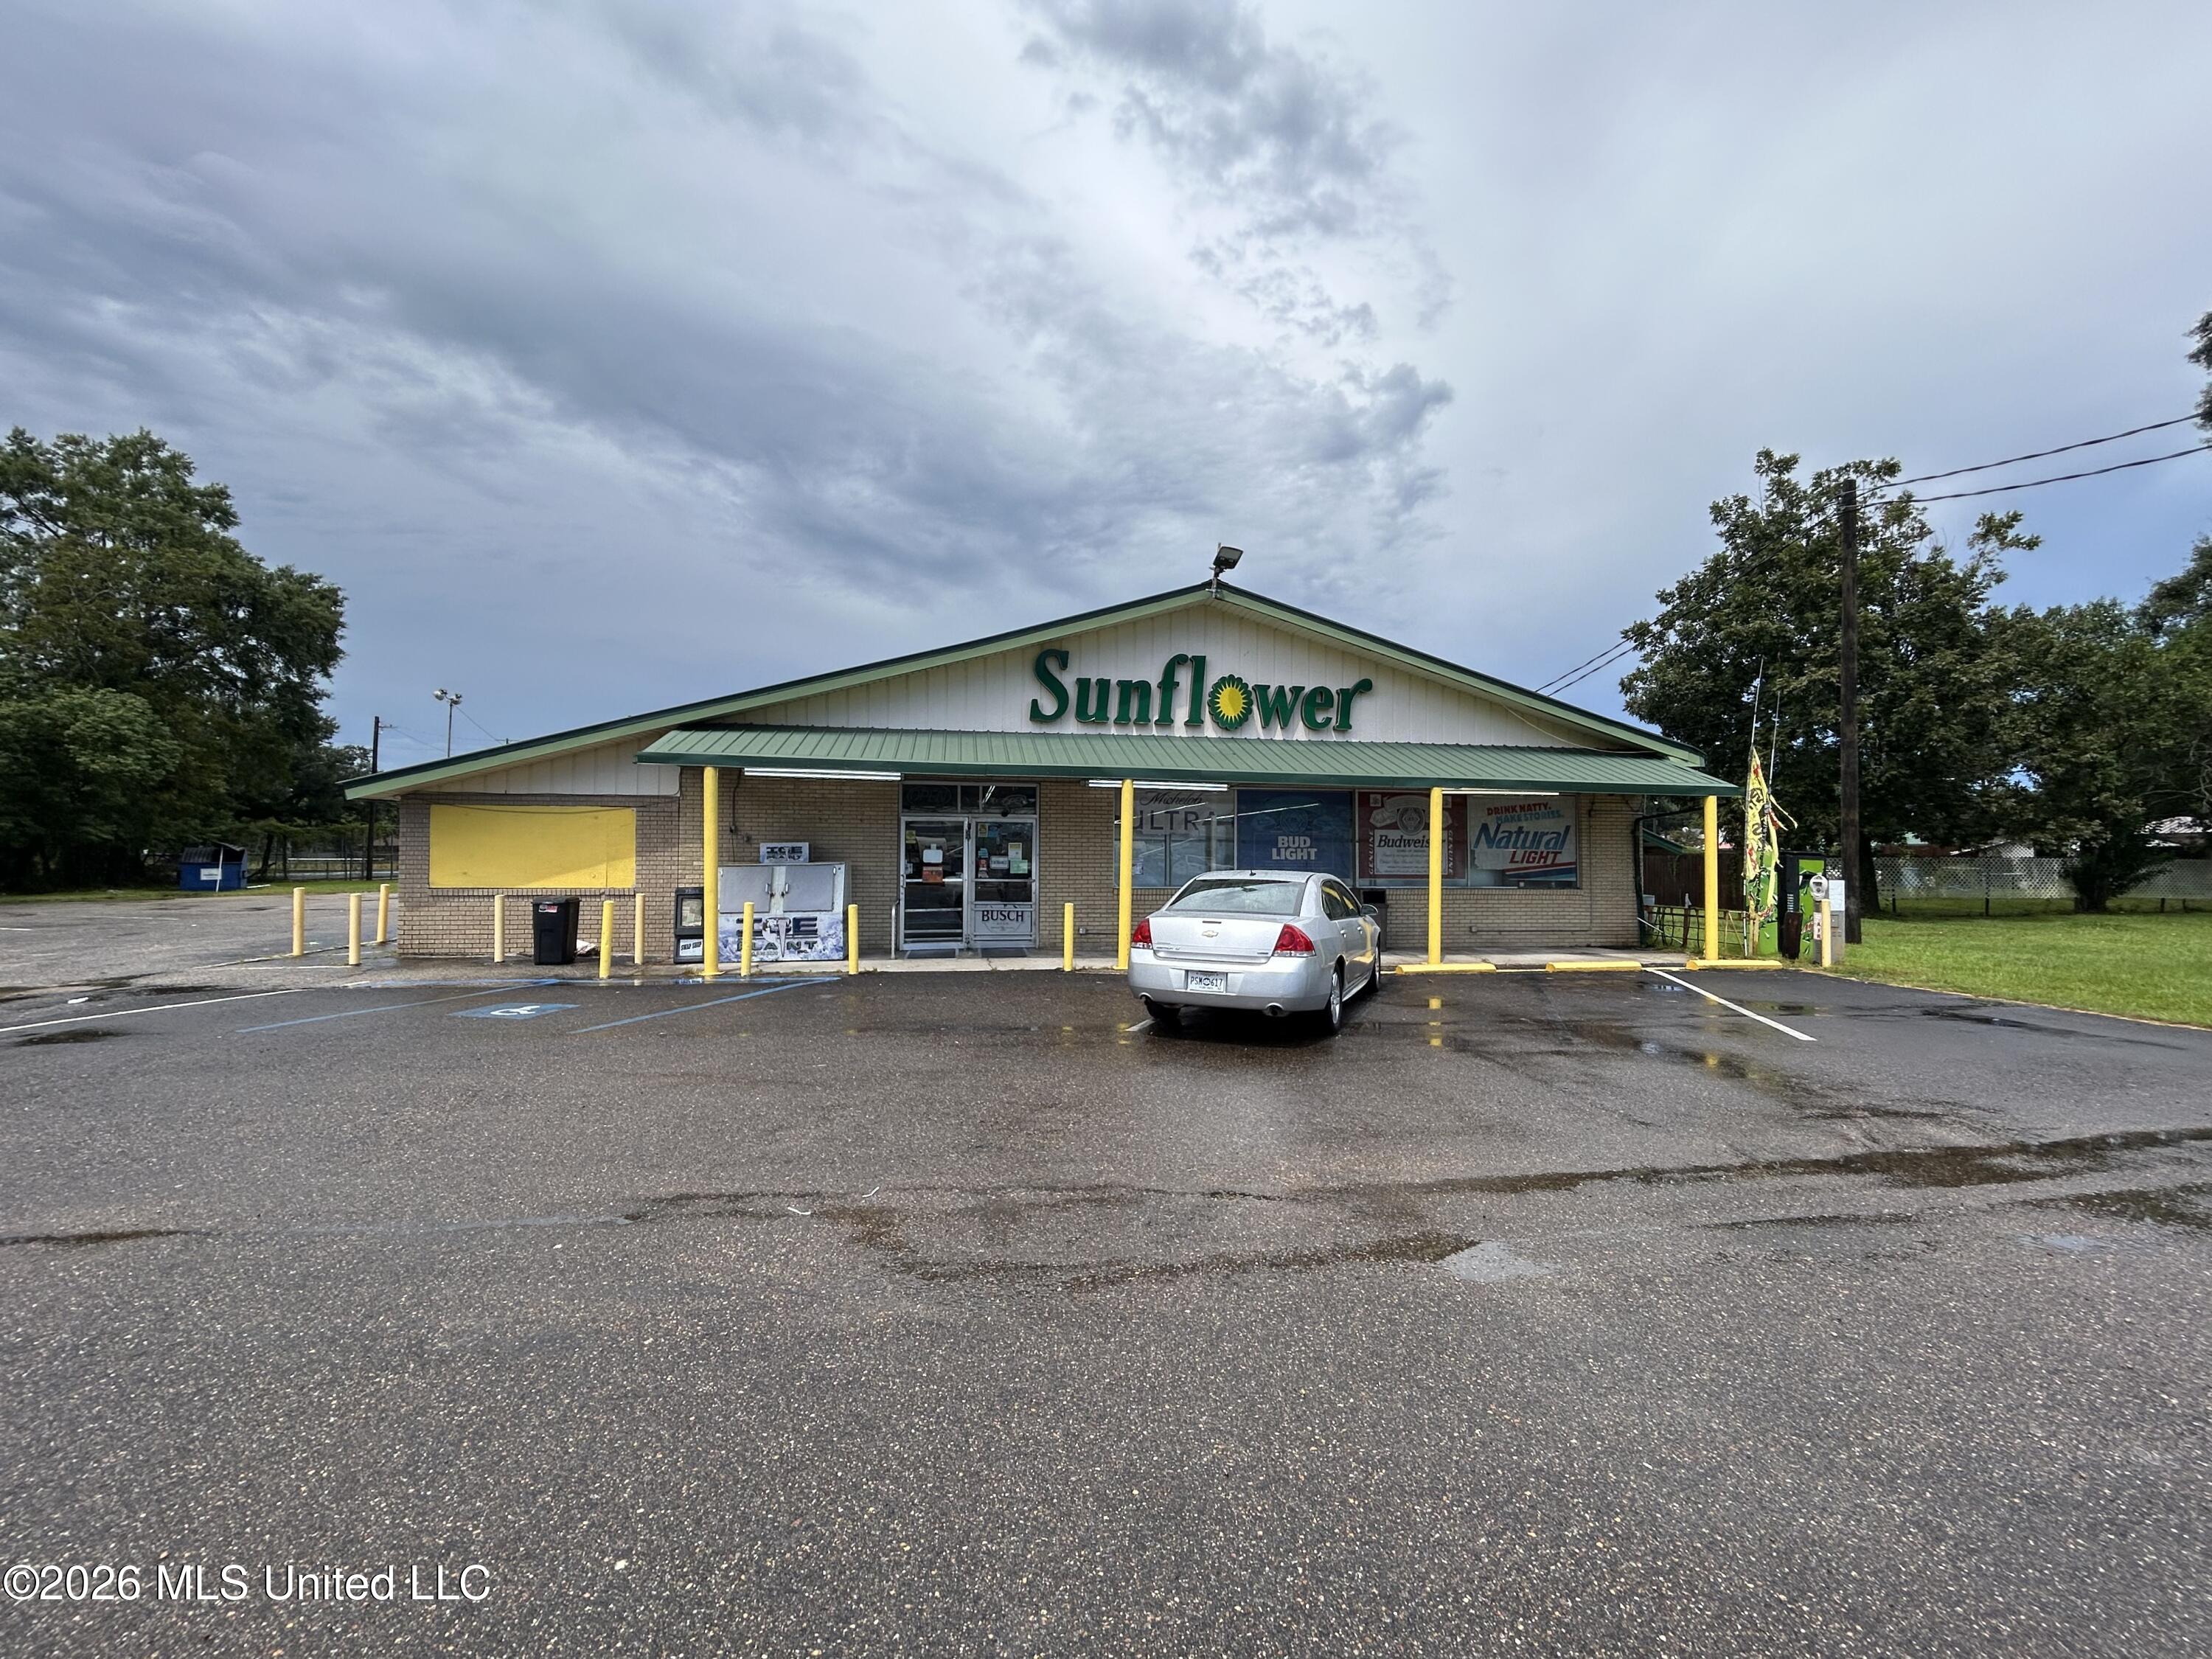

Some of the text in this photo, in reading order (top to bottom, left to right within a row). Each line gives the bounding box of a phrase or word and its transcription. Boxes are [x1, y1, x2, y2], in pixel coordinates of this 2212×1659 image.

[1029, 648, 1372, 730] Sunflower
[1139, 790, 1203, 805] Michelob
[1486, 802, 1552, 815] DRINK NATTY.
[1495, 814, 1523, 824] MAKE
[1278, 836, 1311, 848] BUD
[1473, 823, 1571, 849] Natural
[1271, 848, 1318, 860] LIGHT
[1509, 850, 1562, 864] LIGHT
[981, 911, 1023, 922] BUSCH
[1190, 976, 1223, 987] PSM 617
